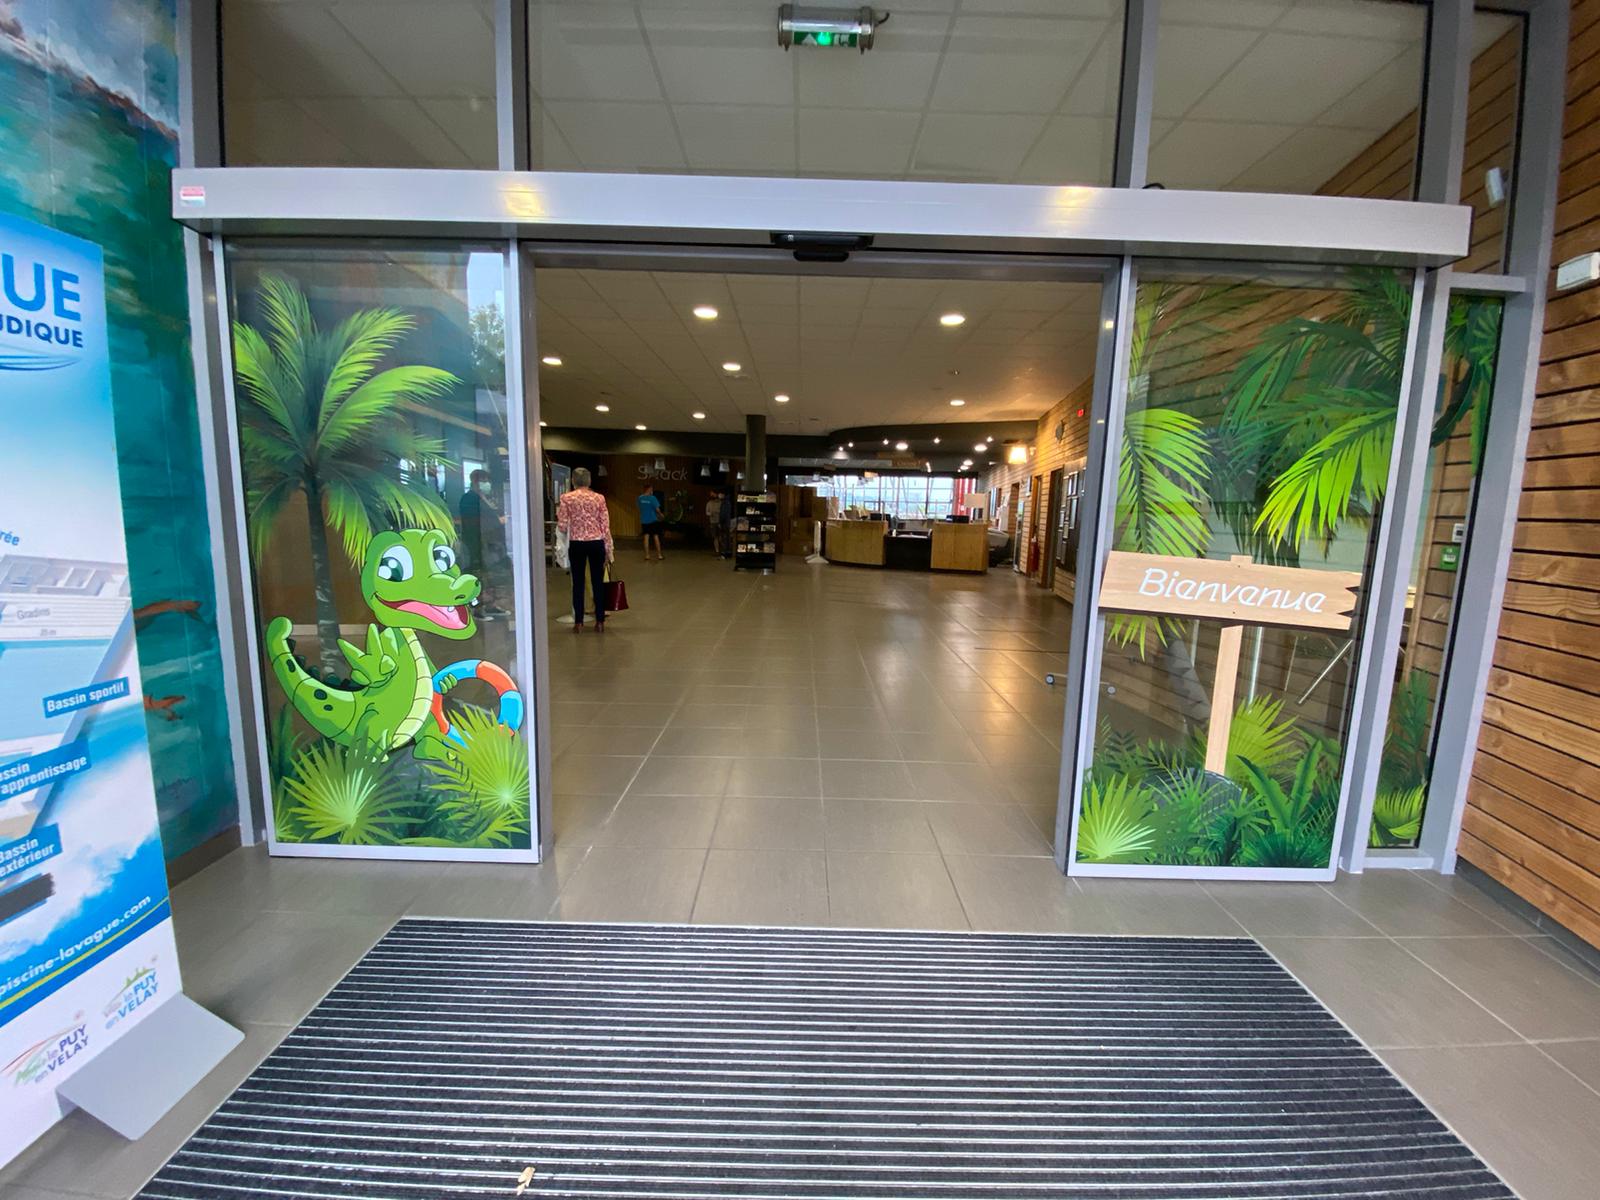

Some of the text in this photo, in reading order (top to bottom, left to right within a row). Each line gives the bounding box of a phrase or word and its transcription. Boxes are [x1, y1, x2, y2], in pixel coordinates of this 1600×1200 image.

[0, 313, 84, 348] DIQUE
[1138, 567, 1327, 613] Bienvenue
[47, 682, 125, 712] Bassin sportif
[1, 756, 87, 794] apprentissage
[118, 982, 158, 1018] VELAY
[133, 971, 156, 995] PUY
[47, 1035, 88, 1071] VELAY
[59, 1024, 86, 1052] PUY
